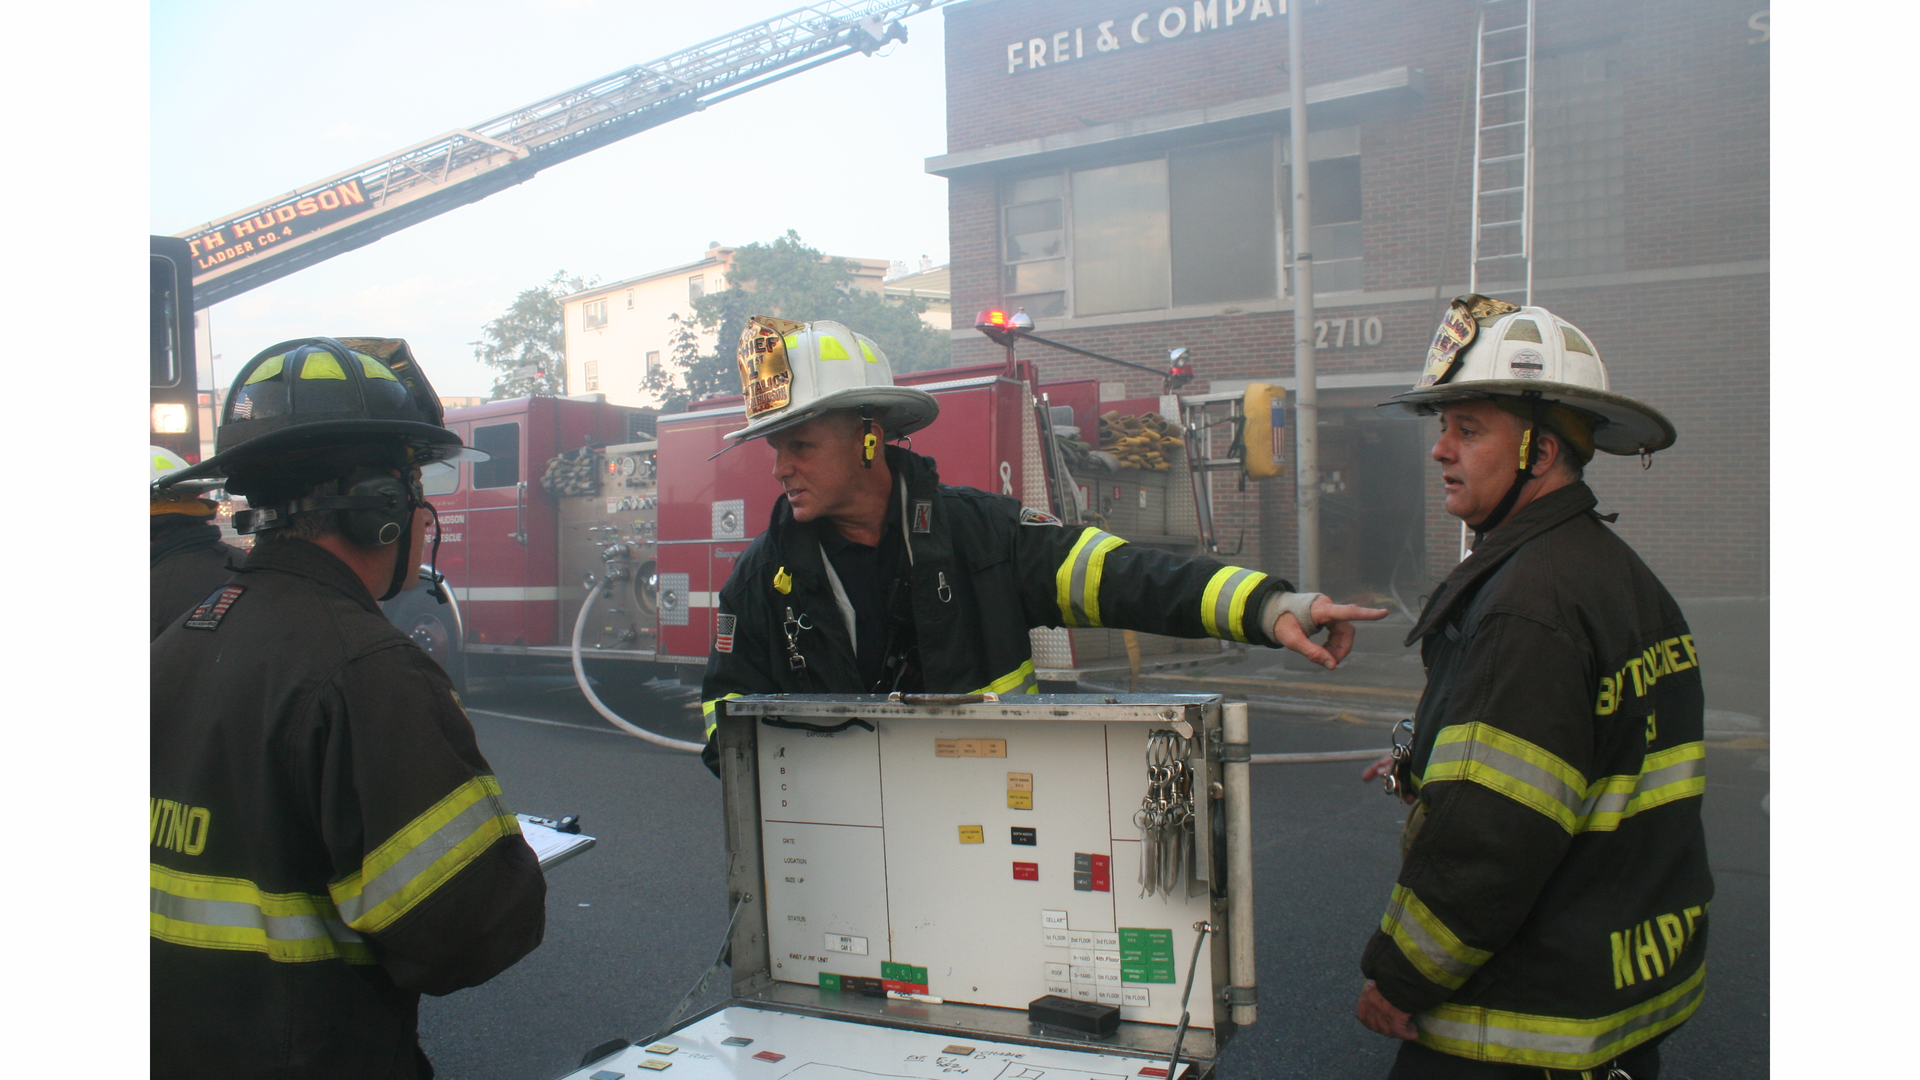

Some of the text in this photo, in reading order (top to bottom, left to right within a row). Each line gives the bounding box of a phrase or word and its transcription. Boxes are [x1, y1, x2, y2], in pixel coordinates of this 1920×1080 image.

[1008, 28, 1083, 74] FREI
[1096, 20, 1120, 51] &
[234, 179, 366, 239] HUDSON
[199, 226, 293, 270] LADDER CO. 4
[1313, 317, 1383, 349] 2710
[780, 767, 786, 775] B
[1610, 902, 1710, 990] NHRF
